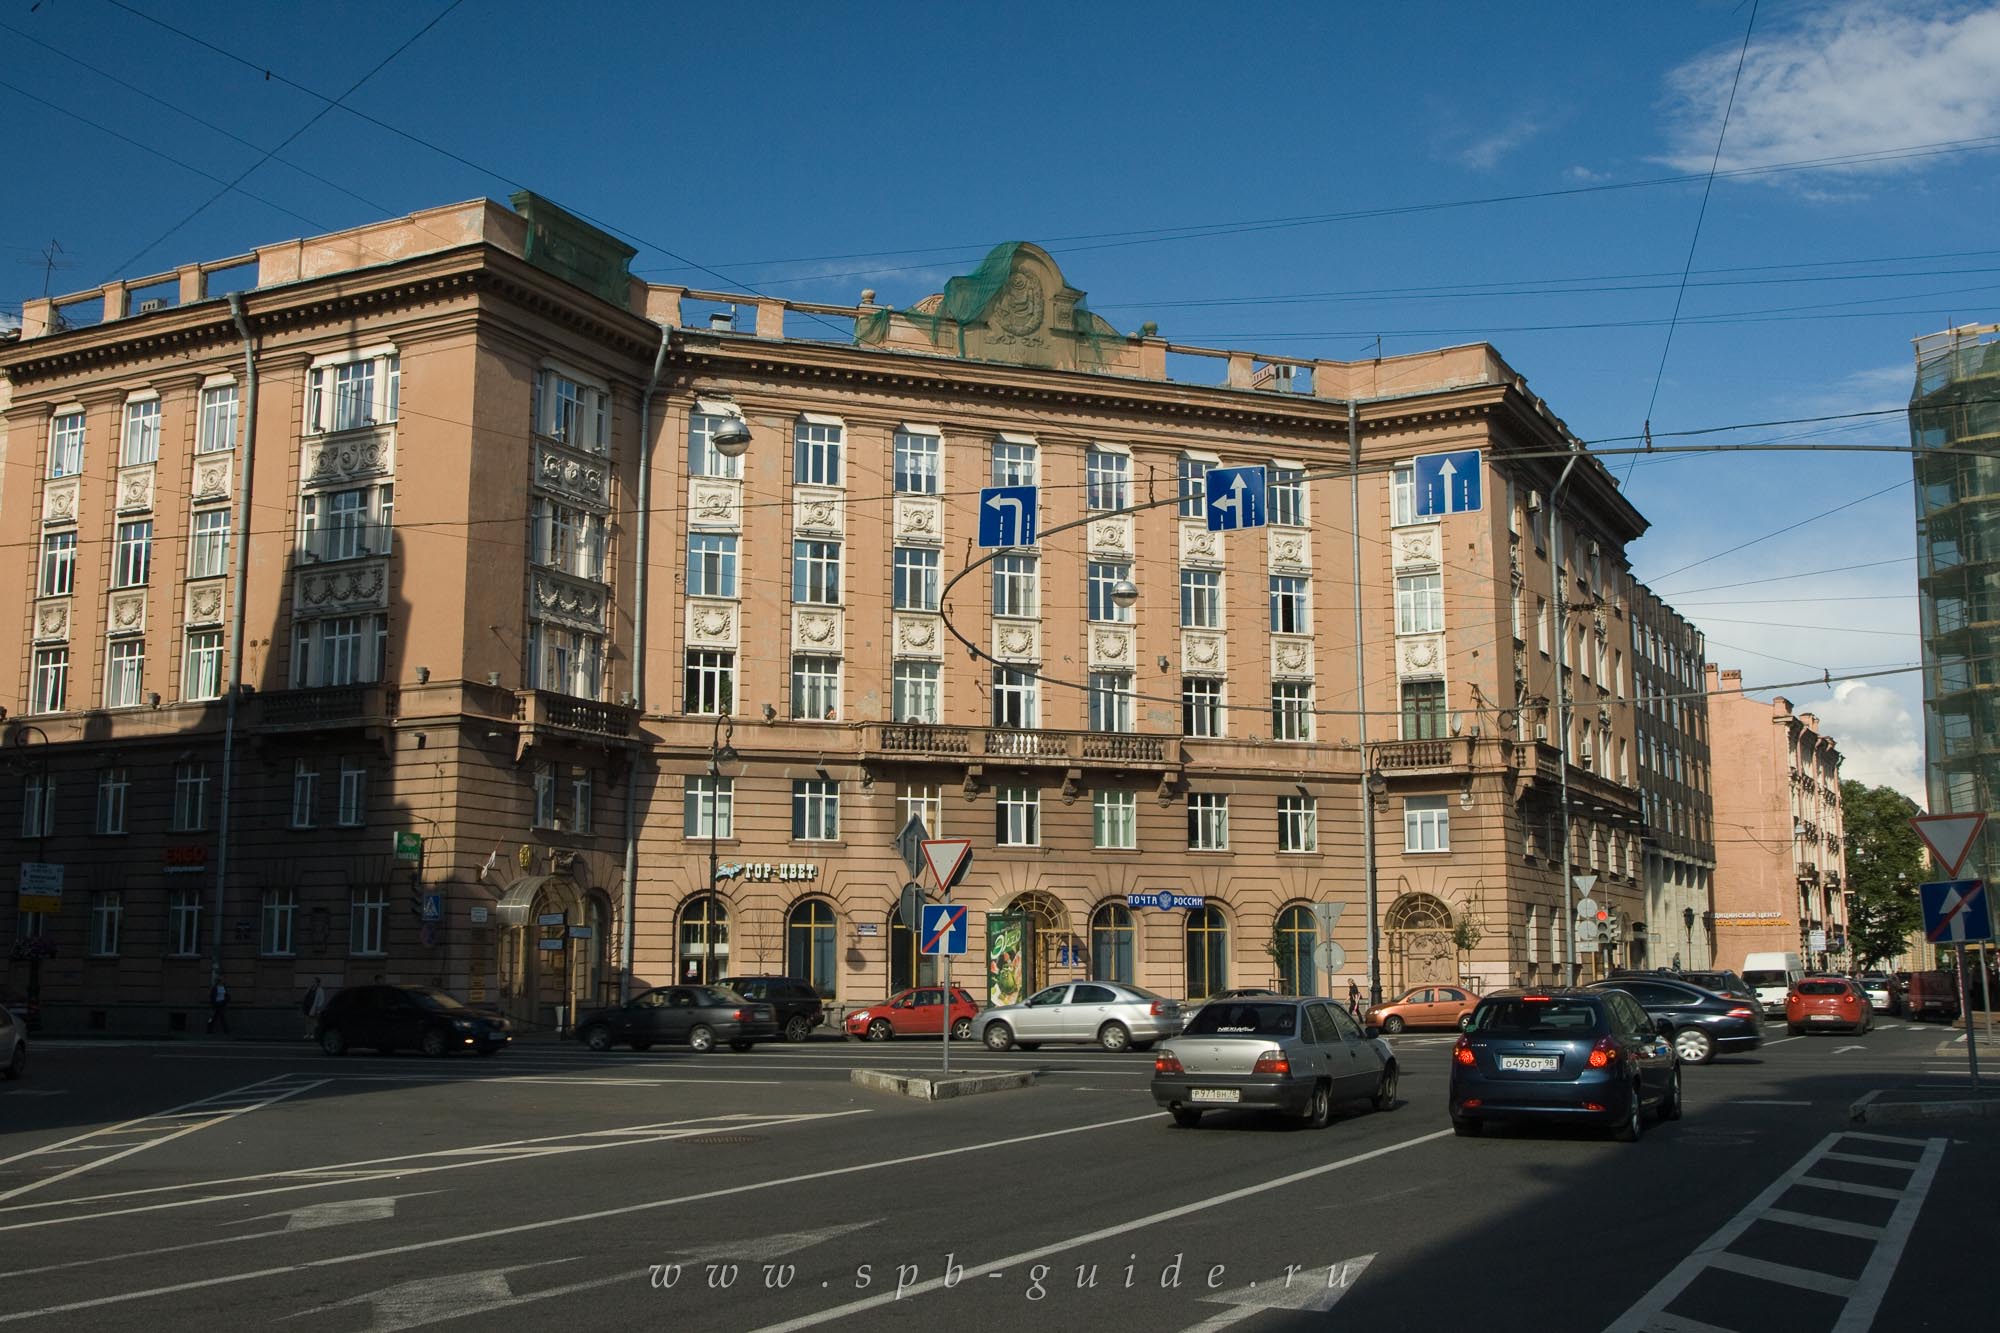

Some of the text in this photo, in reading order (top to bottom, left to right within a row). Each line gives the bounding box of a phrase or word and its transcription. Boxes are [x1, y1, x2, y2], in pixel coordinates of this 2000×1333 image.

[745, 863, 814, 880] ГОР-ЦВЕТ
[1128, 895, 1203, 906] ПОЧТА РОССИИ
